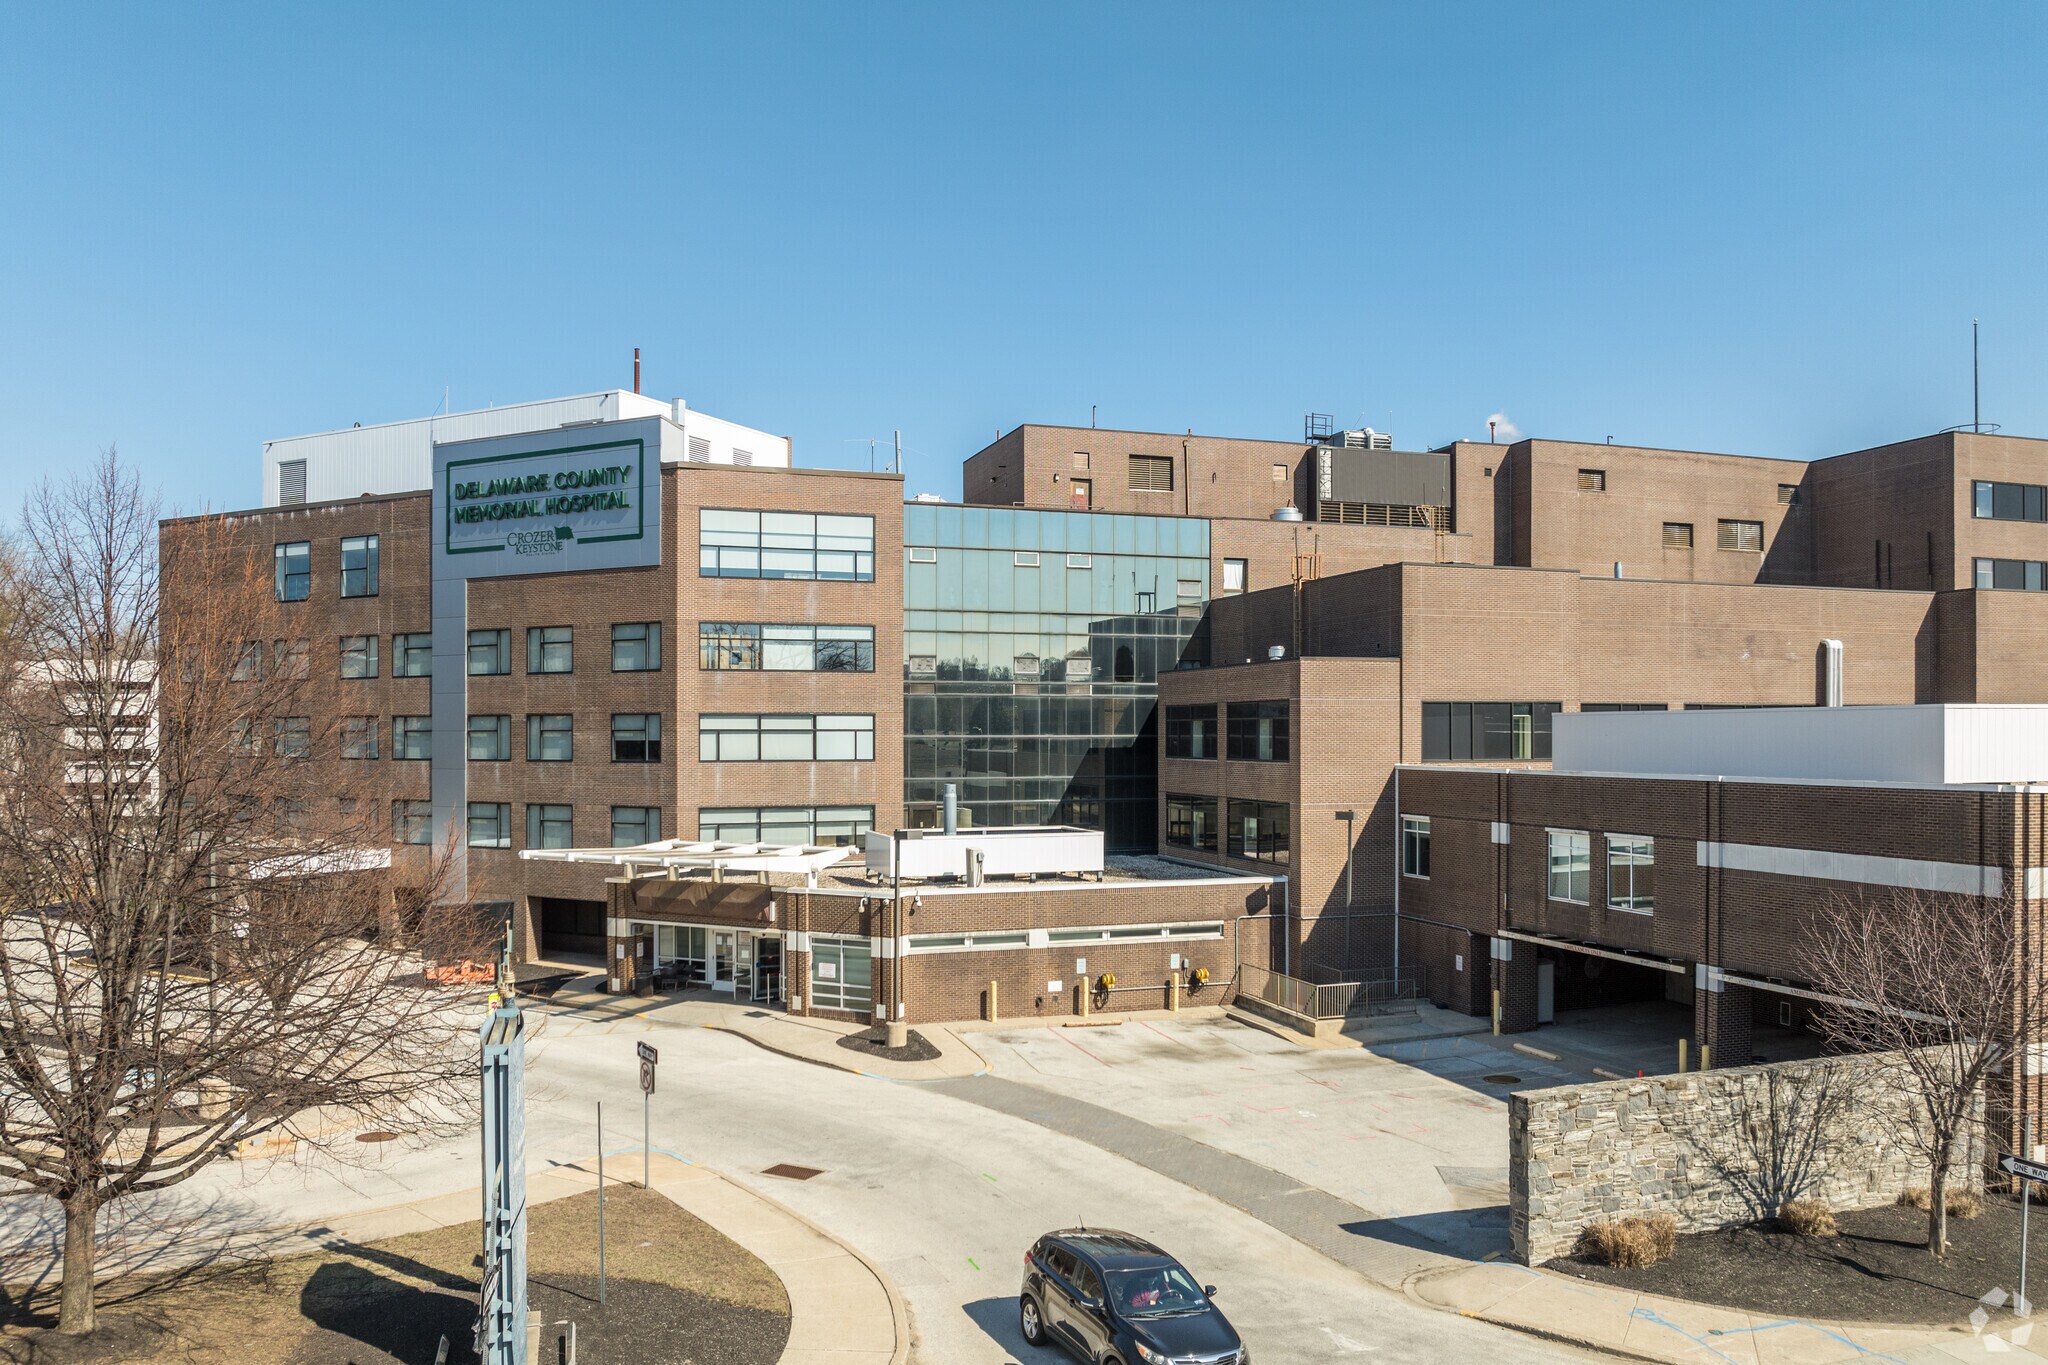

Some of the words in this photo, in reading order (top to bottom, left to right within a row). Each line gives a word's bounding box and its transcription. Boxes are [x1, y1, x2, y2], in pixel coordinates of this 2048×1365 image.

[455, 474, 551, 500] DELAWARE
[554, 465, 632, 490] COUNTY
[454, 499, 544, 524] MEMORIAL
[546, 491, 632, 516] HOSPITAL
[507, 530, 555, 547] CROZER
[515, 541, 563, 555] KEYSTONE
[2013, 1163, 2029, 1173] ONE
[2032, 1168, 2048, 1178] WAY
